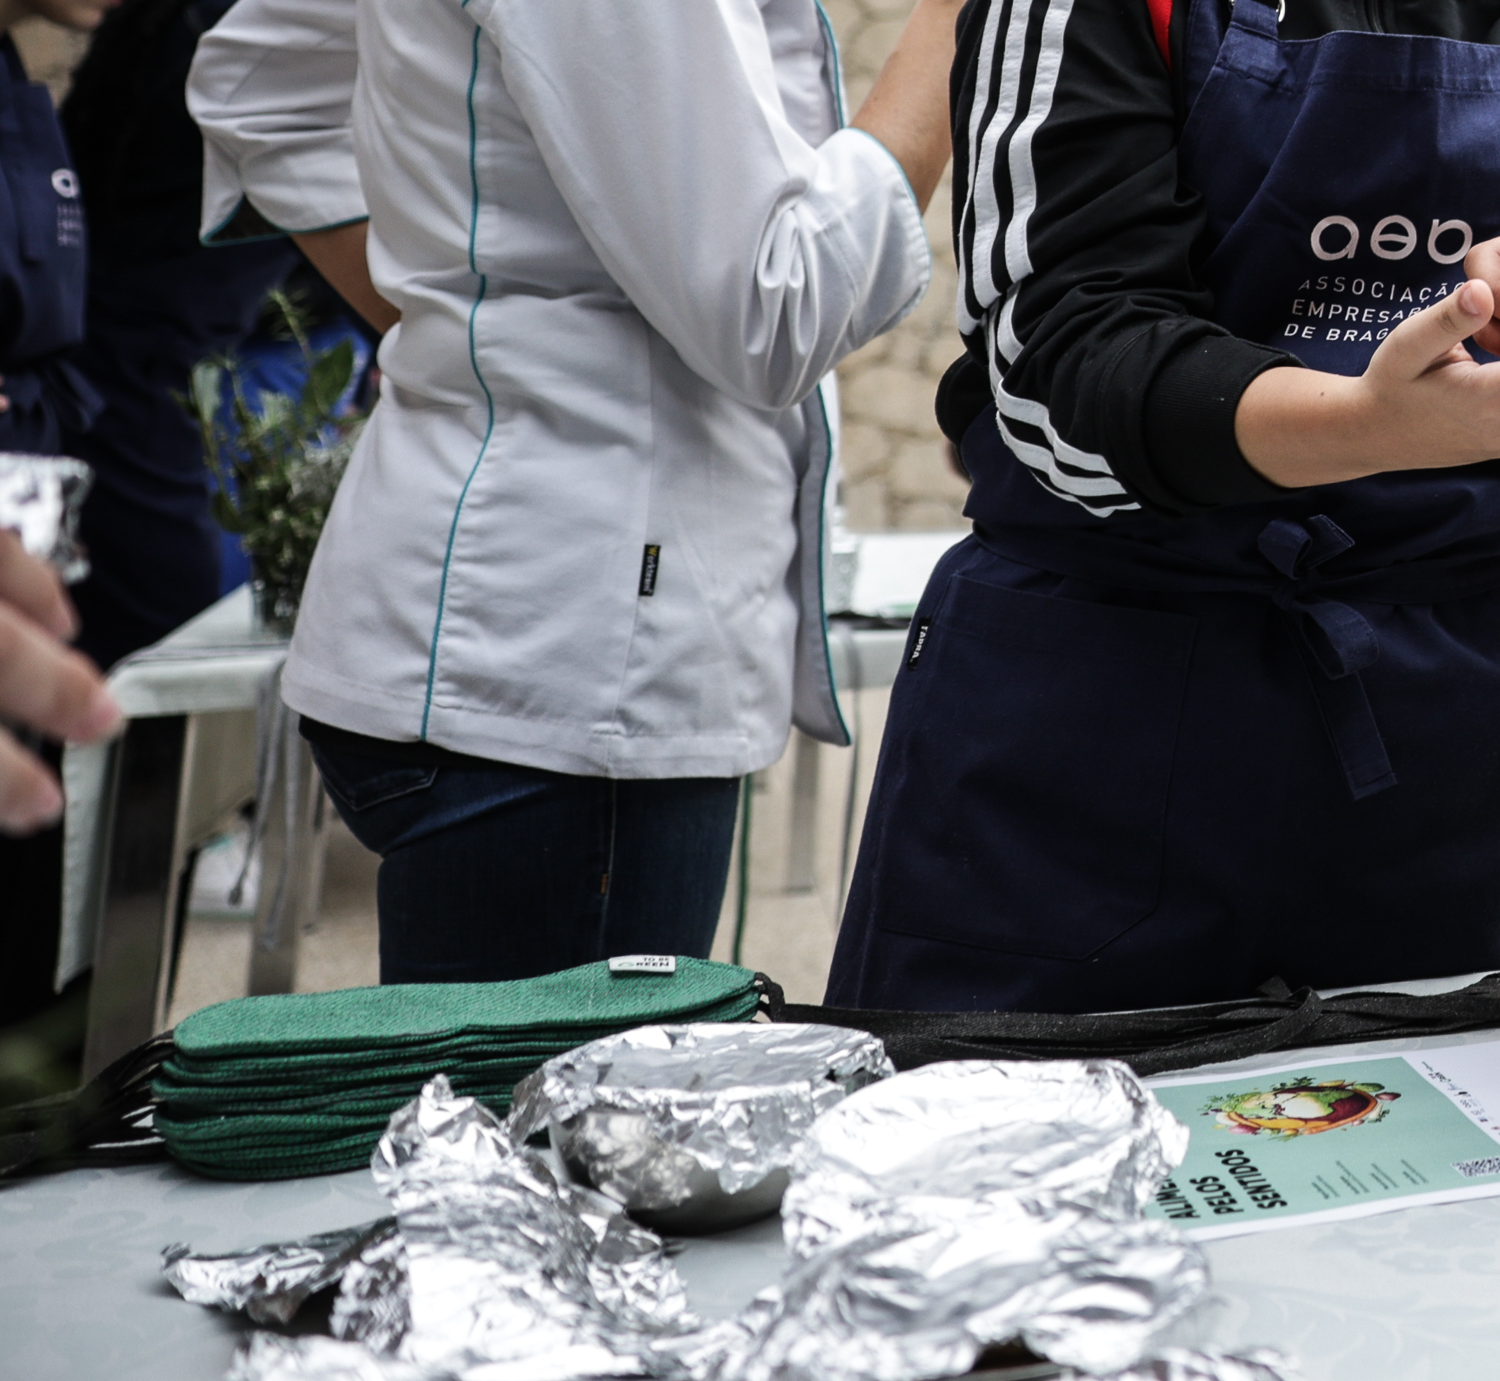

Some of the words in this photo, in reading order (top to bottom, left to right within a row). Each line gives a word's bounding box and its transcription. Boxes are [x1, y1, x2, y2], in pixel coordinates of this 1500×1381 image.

[1284, 323, 1316, 339] DE
[1325, 327, 1389, 342] BRAG
[1156, 1178, 1201, 1219] ALIME
[1189, 1175, 1244, 1215] PELOS
[1214, 1149, 1288, 1209] SENTIDOS
